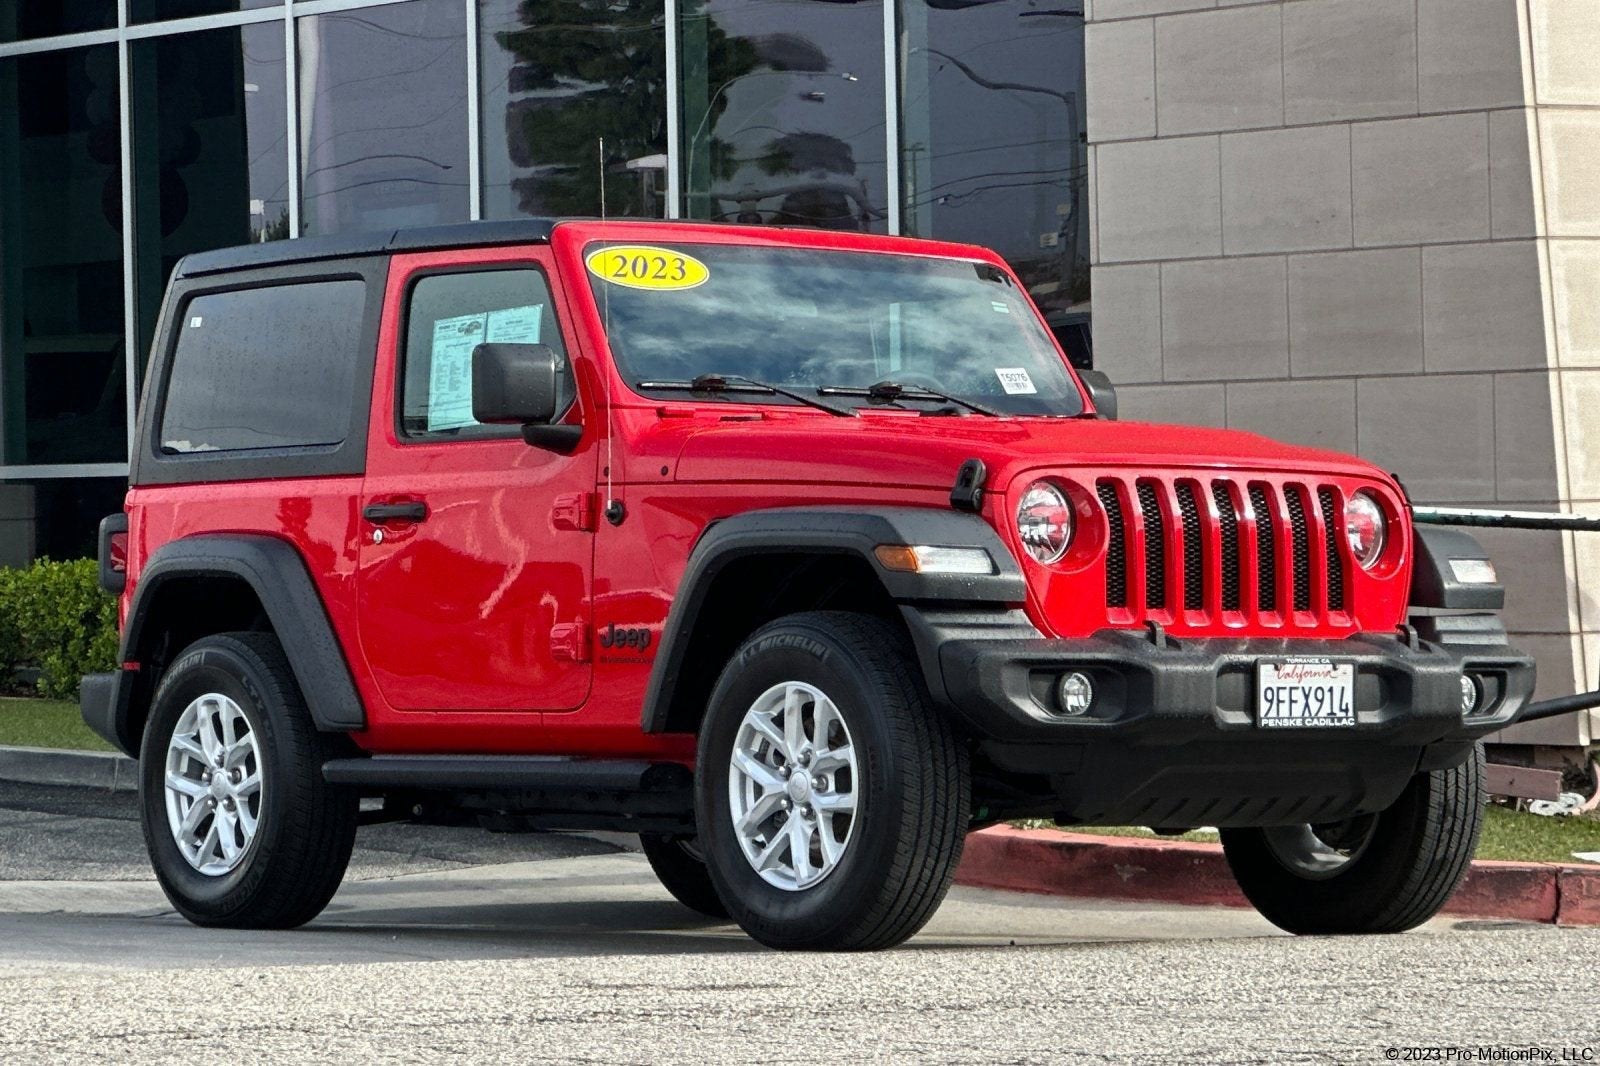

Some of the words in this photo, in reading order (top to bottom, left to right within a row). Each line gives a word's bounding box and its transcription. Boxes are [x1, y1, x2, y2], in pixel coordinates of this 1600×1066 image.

[612, 255, 686, 280] 2023
[600, 621, 651, 652] Jeep
[759, 634, 826, 656] MICHELIN
[1277, 664, 1337, 684] California
[1263, 686, 1350, 717] 9FFX914
[1261, 718, 1303, 727] PENSKE
[1305, 718, 1355, 727] CADILLAC
